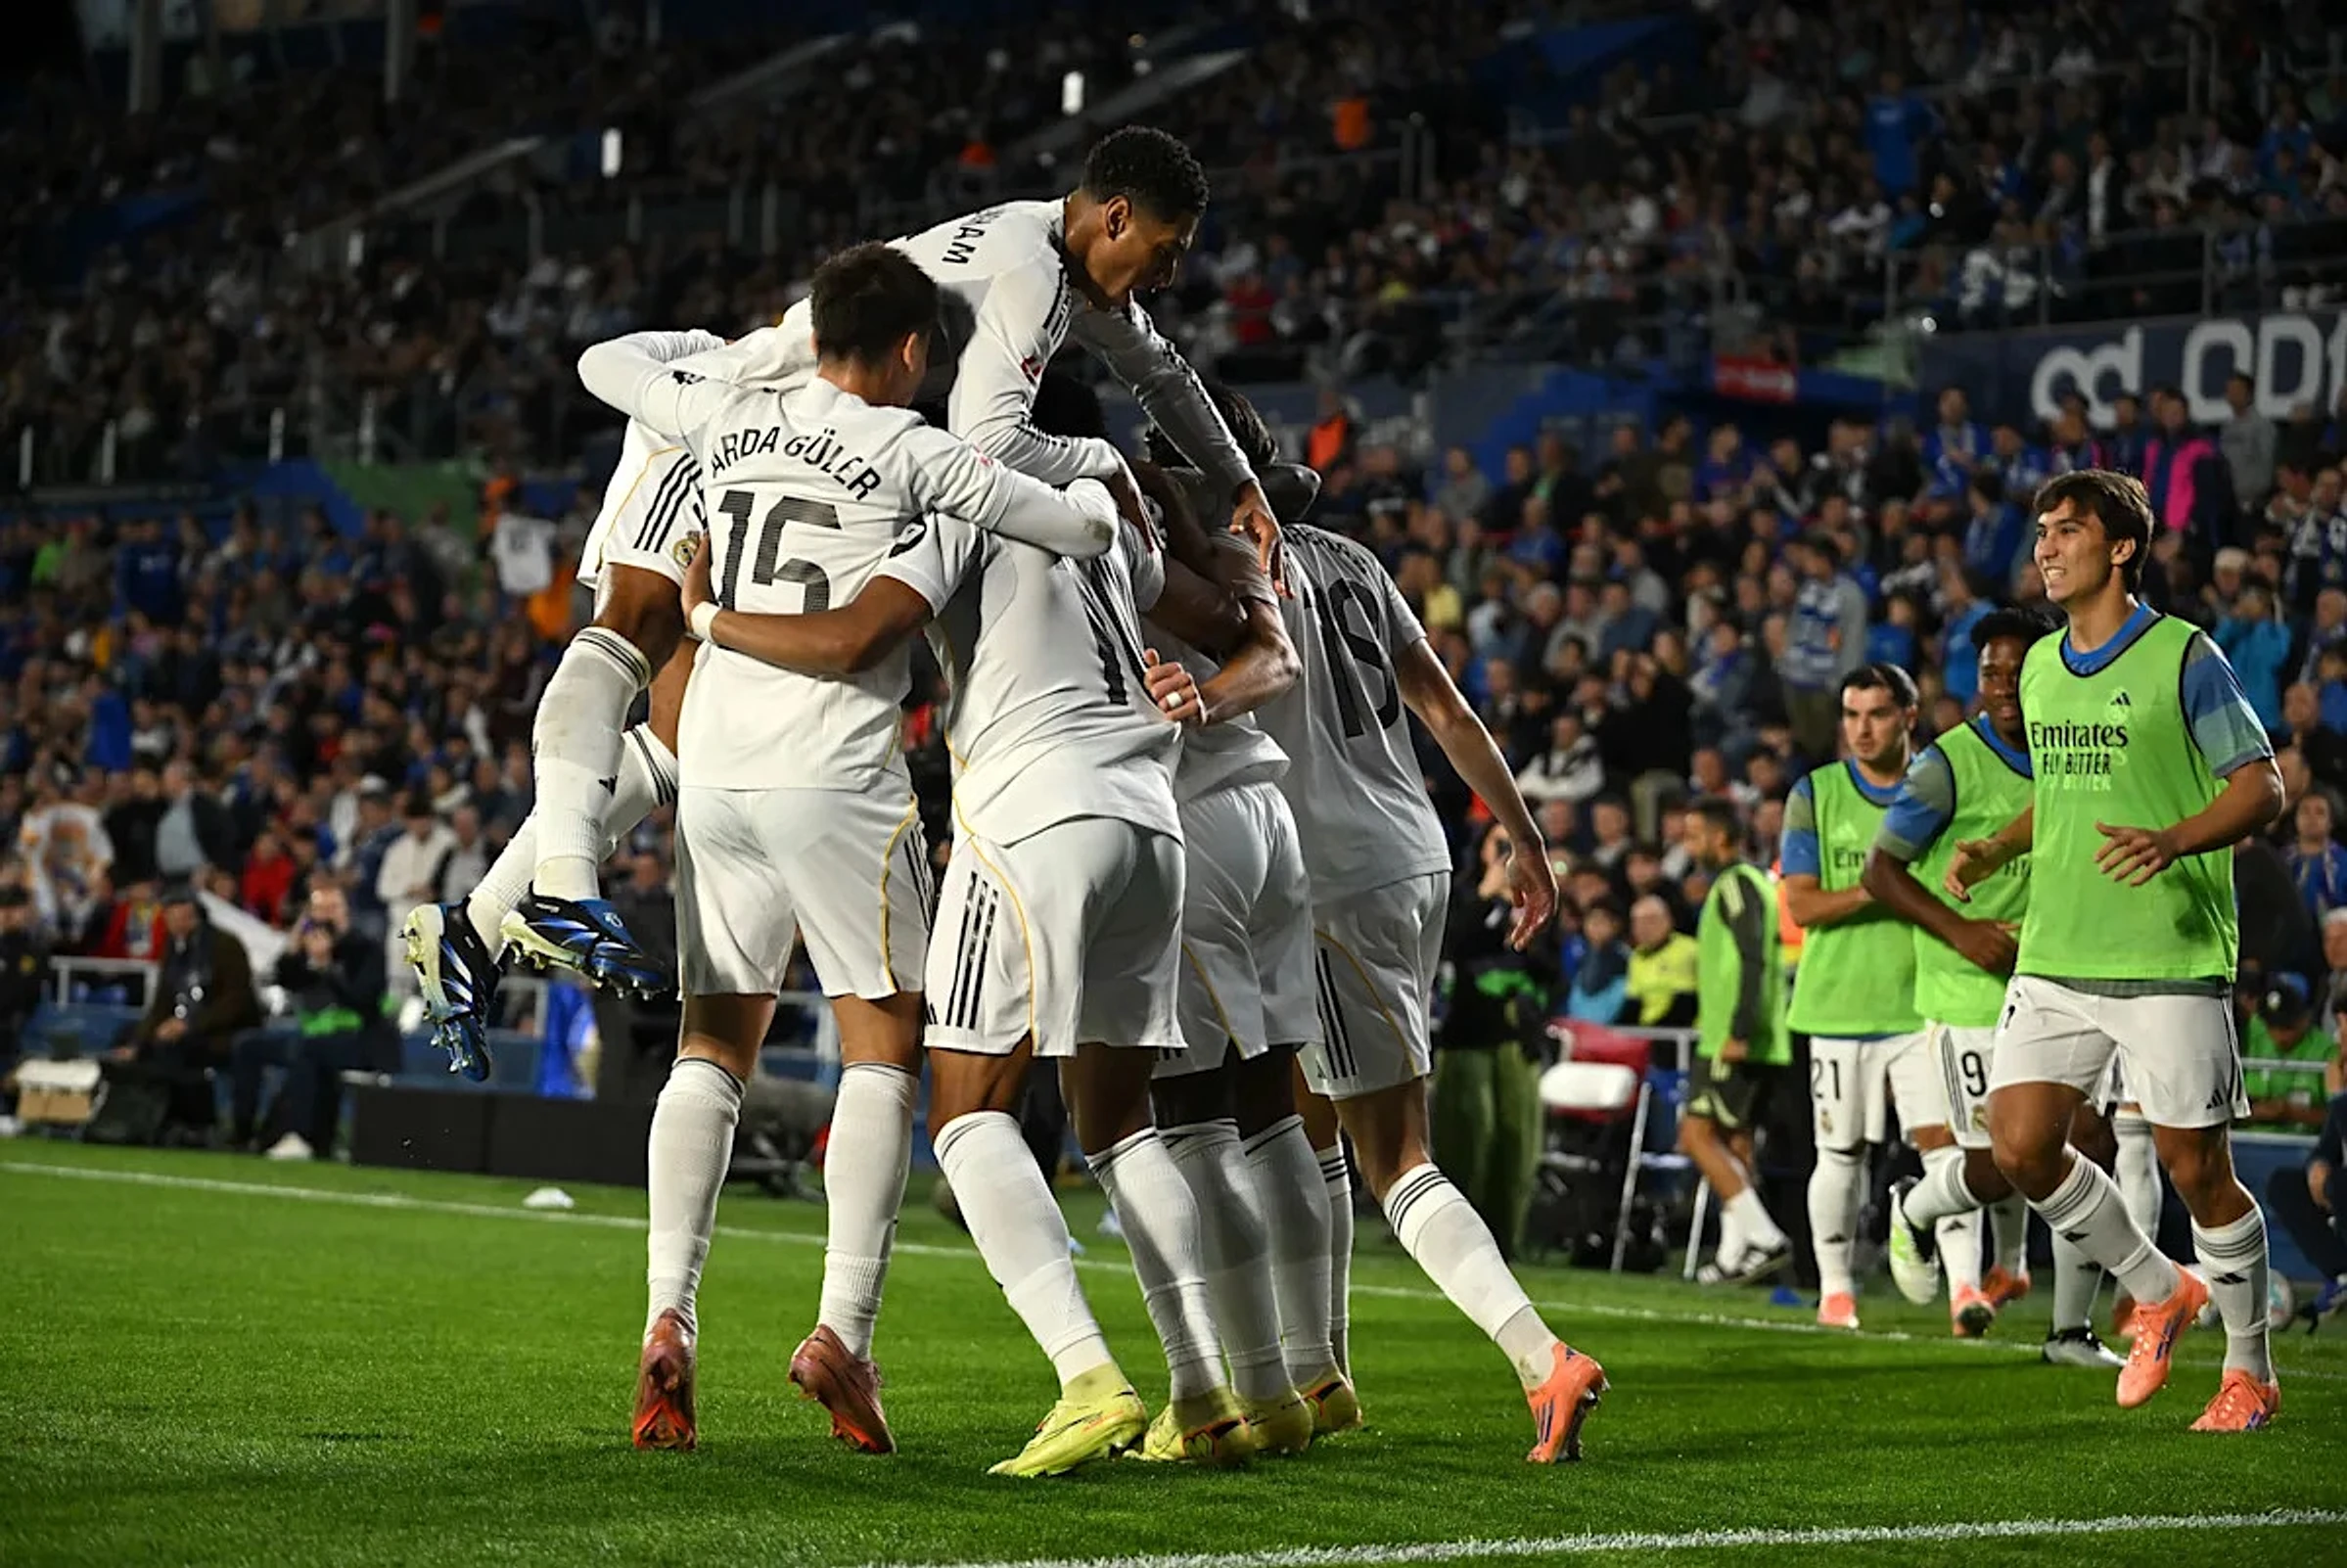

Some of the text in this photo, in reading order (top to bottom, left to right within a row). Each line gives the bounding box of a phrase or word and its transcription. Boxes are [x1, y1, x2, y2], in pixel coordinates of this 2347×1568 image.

[711, 426, 882, 501] ARDA GÜLER
[718, 489, 842, 614] 15
[1303, 576, 1400, 738] 19
[2030, 719, 2130, 749] Emirates
[2064, 753, 2111, 775] BETTER
[1811, 1057, 1841, 1100] 21
[1961, 1050, 1988, 1097] 9
